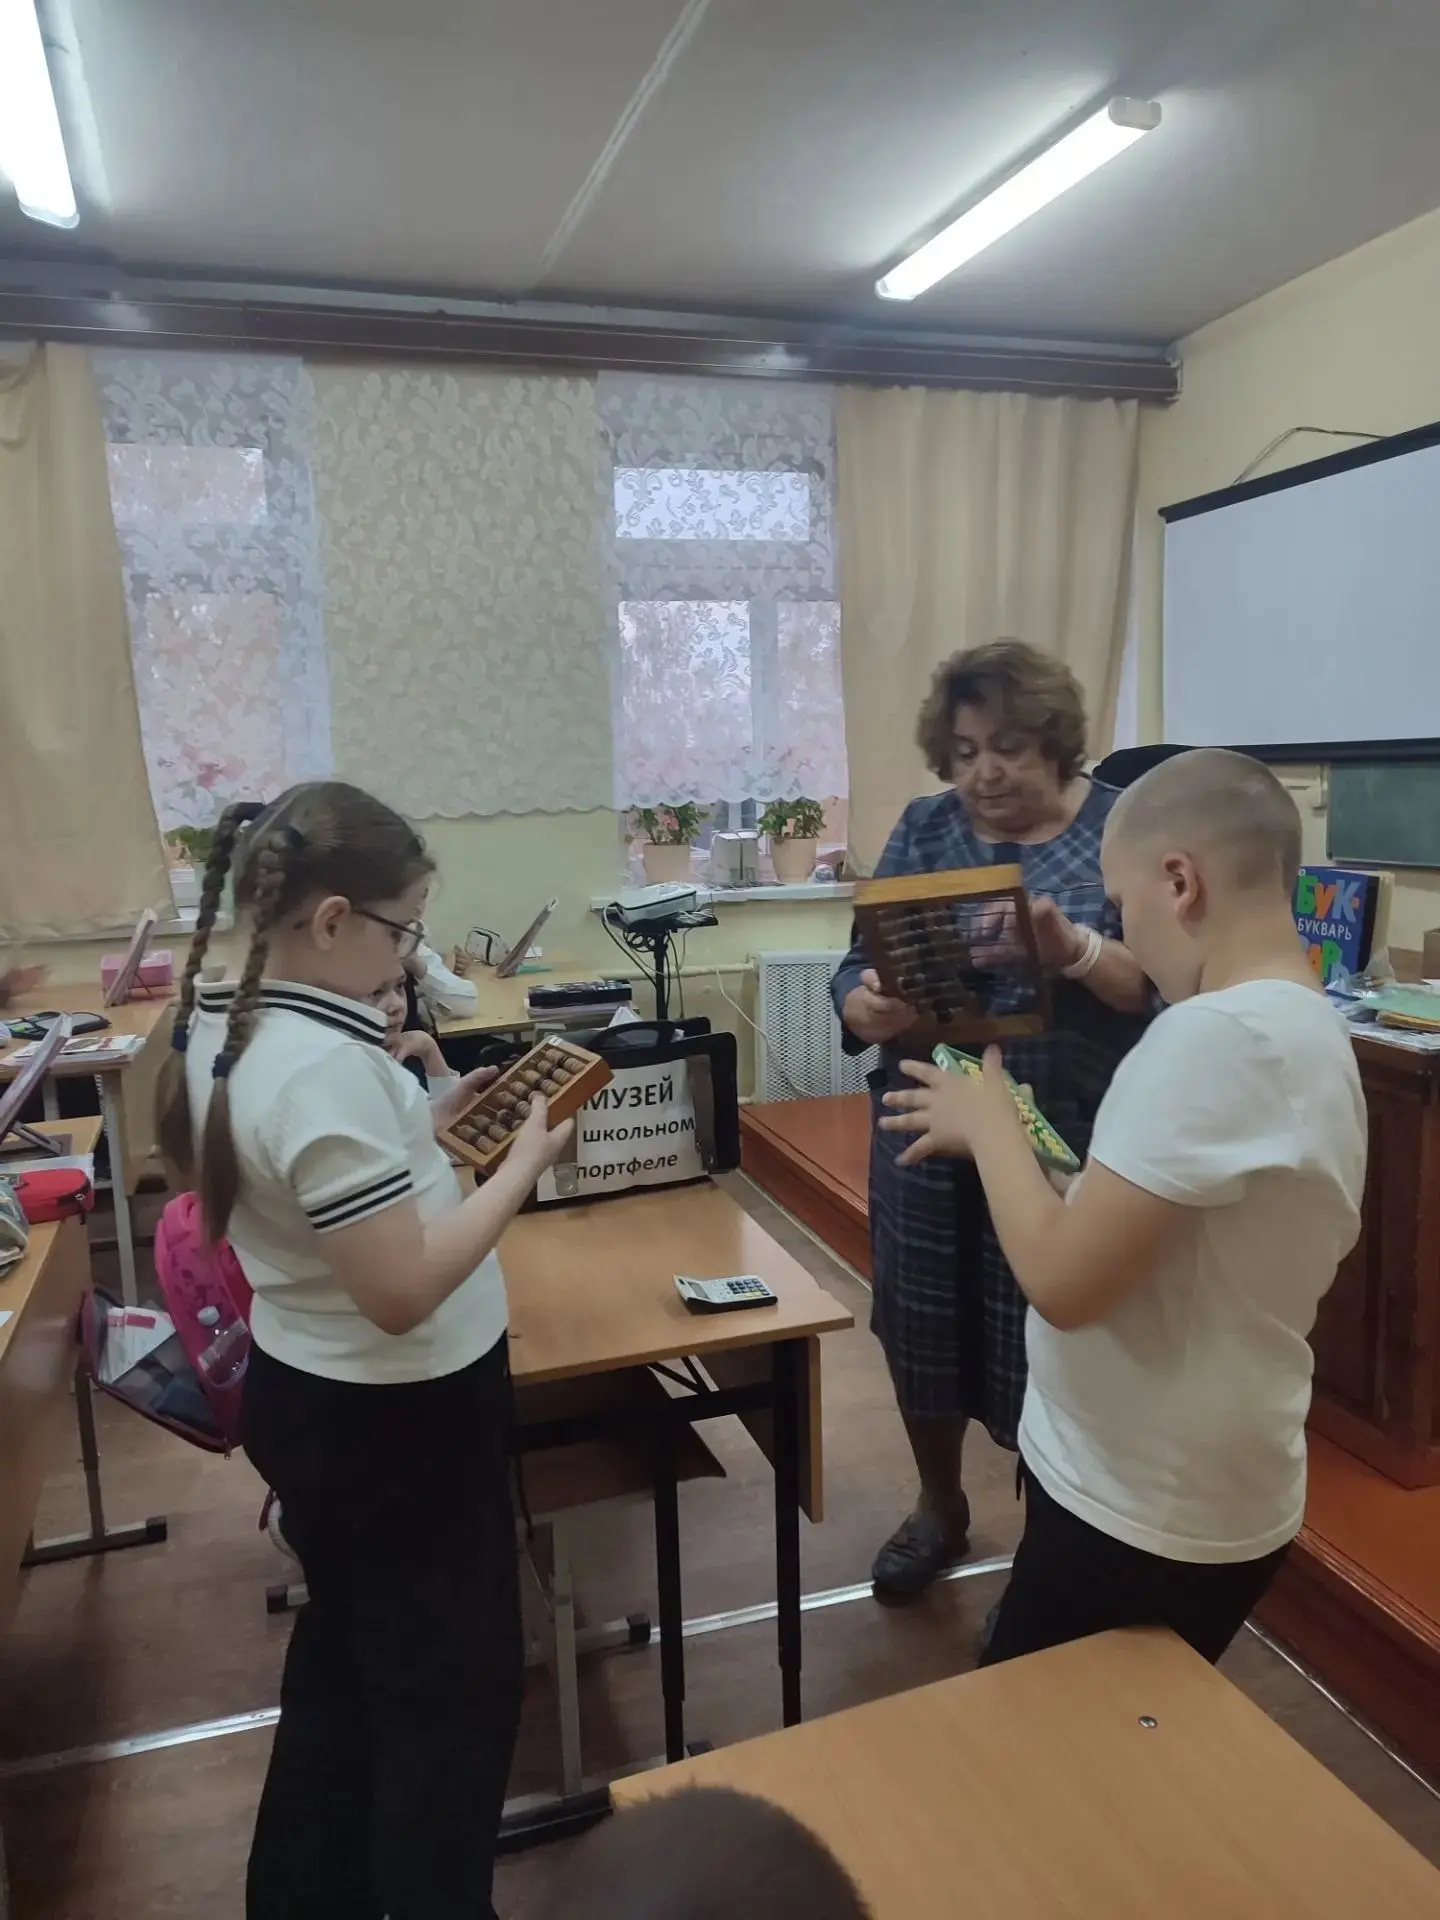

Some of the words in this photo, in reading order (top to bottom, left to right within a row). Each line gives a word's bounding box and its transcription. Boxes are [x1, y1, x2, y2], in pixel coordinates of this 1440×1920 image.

[1297, 918, 1352, 940] БУКВАРЬ
[582, 1117, 695, 1143] школьном
[576, 1154, 678, 1180] портфеле
